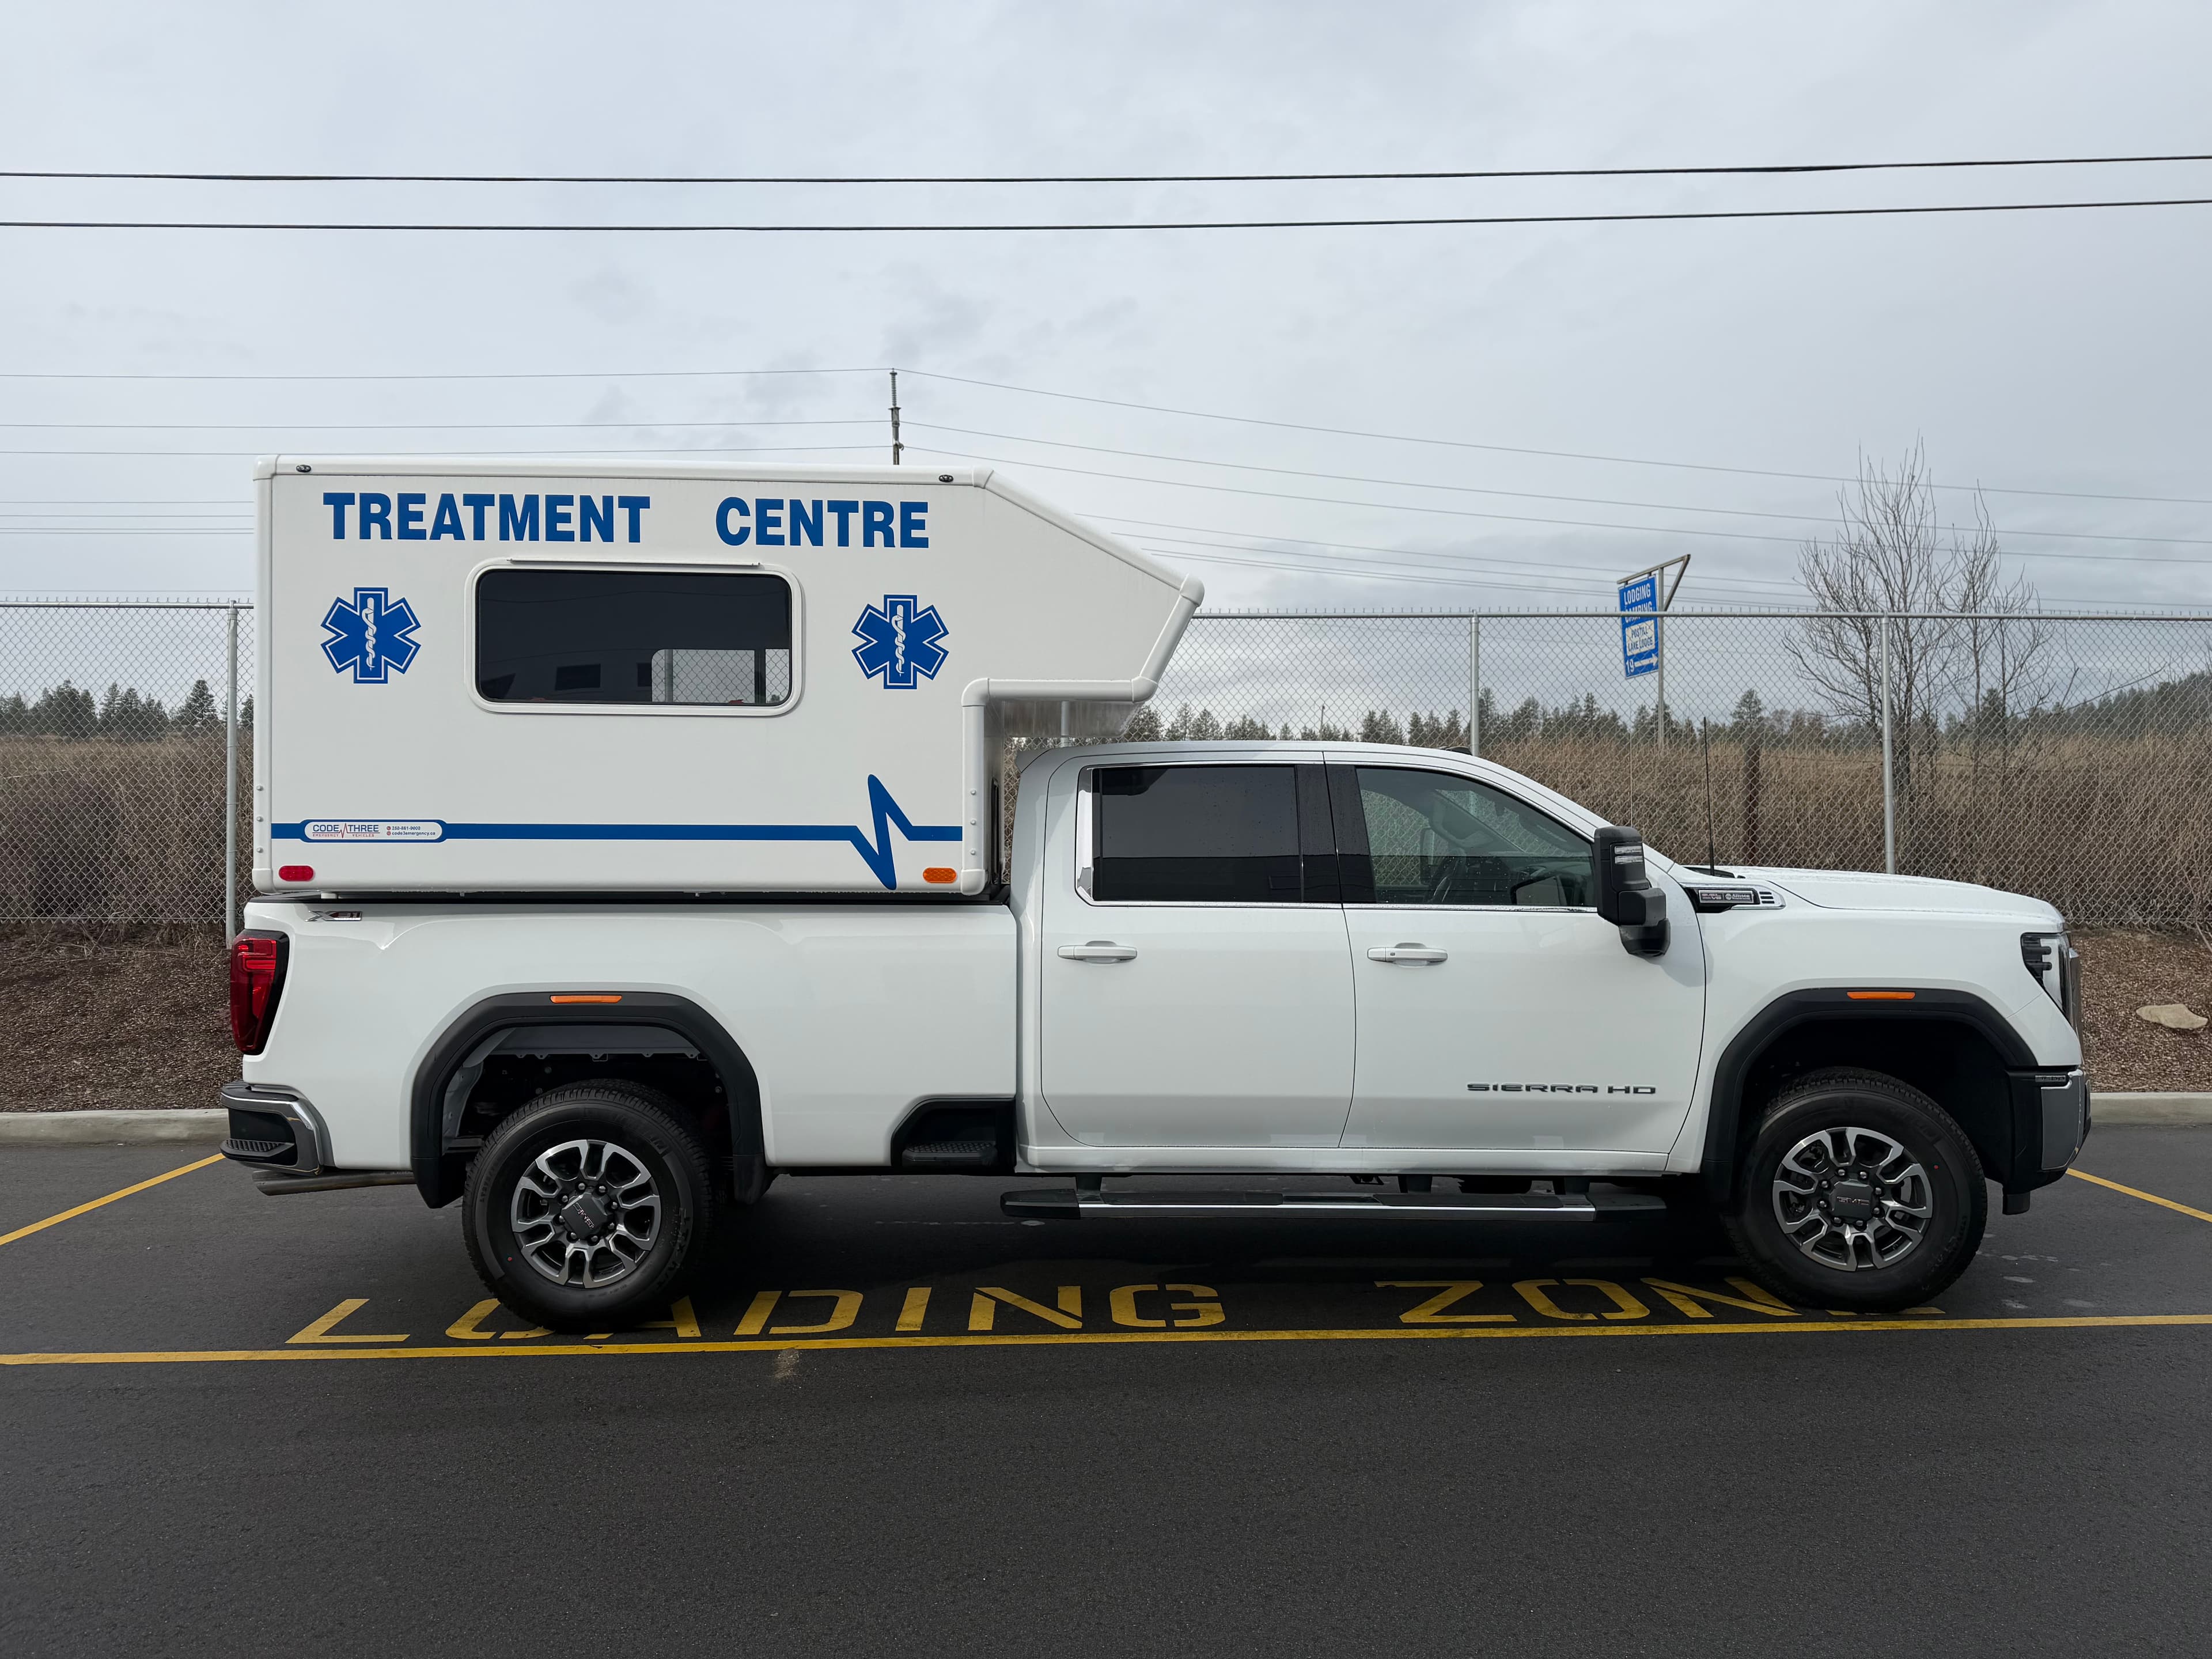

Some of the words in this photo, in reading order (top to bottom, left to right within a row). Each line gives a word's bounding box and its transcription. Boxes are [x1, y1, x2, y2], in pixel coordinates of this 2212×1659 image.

[323, 493, 650, 543] TREATMENT
[716, 497, 929, 548] CENTRE
[1623, 583, 1651, 605] LODGING
[1628, 641, 1639, 652] LAKE
[1639, 636, 1653, 649] LODGE
[1626, 658, 1634, 673] 19
[1467, 1083, 1598, 1093] SIERRA
[1607, 1085, 1656, 1094] HD
[1837, 1196, 1870, 1206] GMC
[1373, 1277, 1945, 1323] ZON
